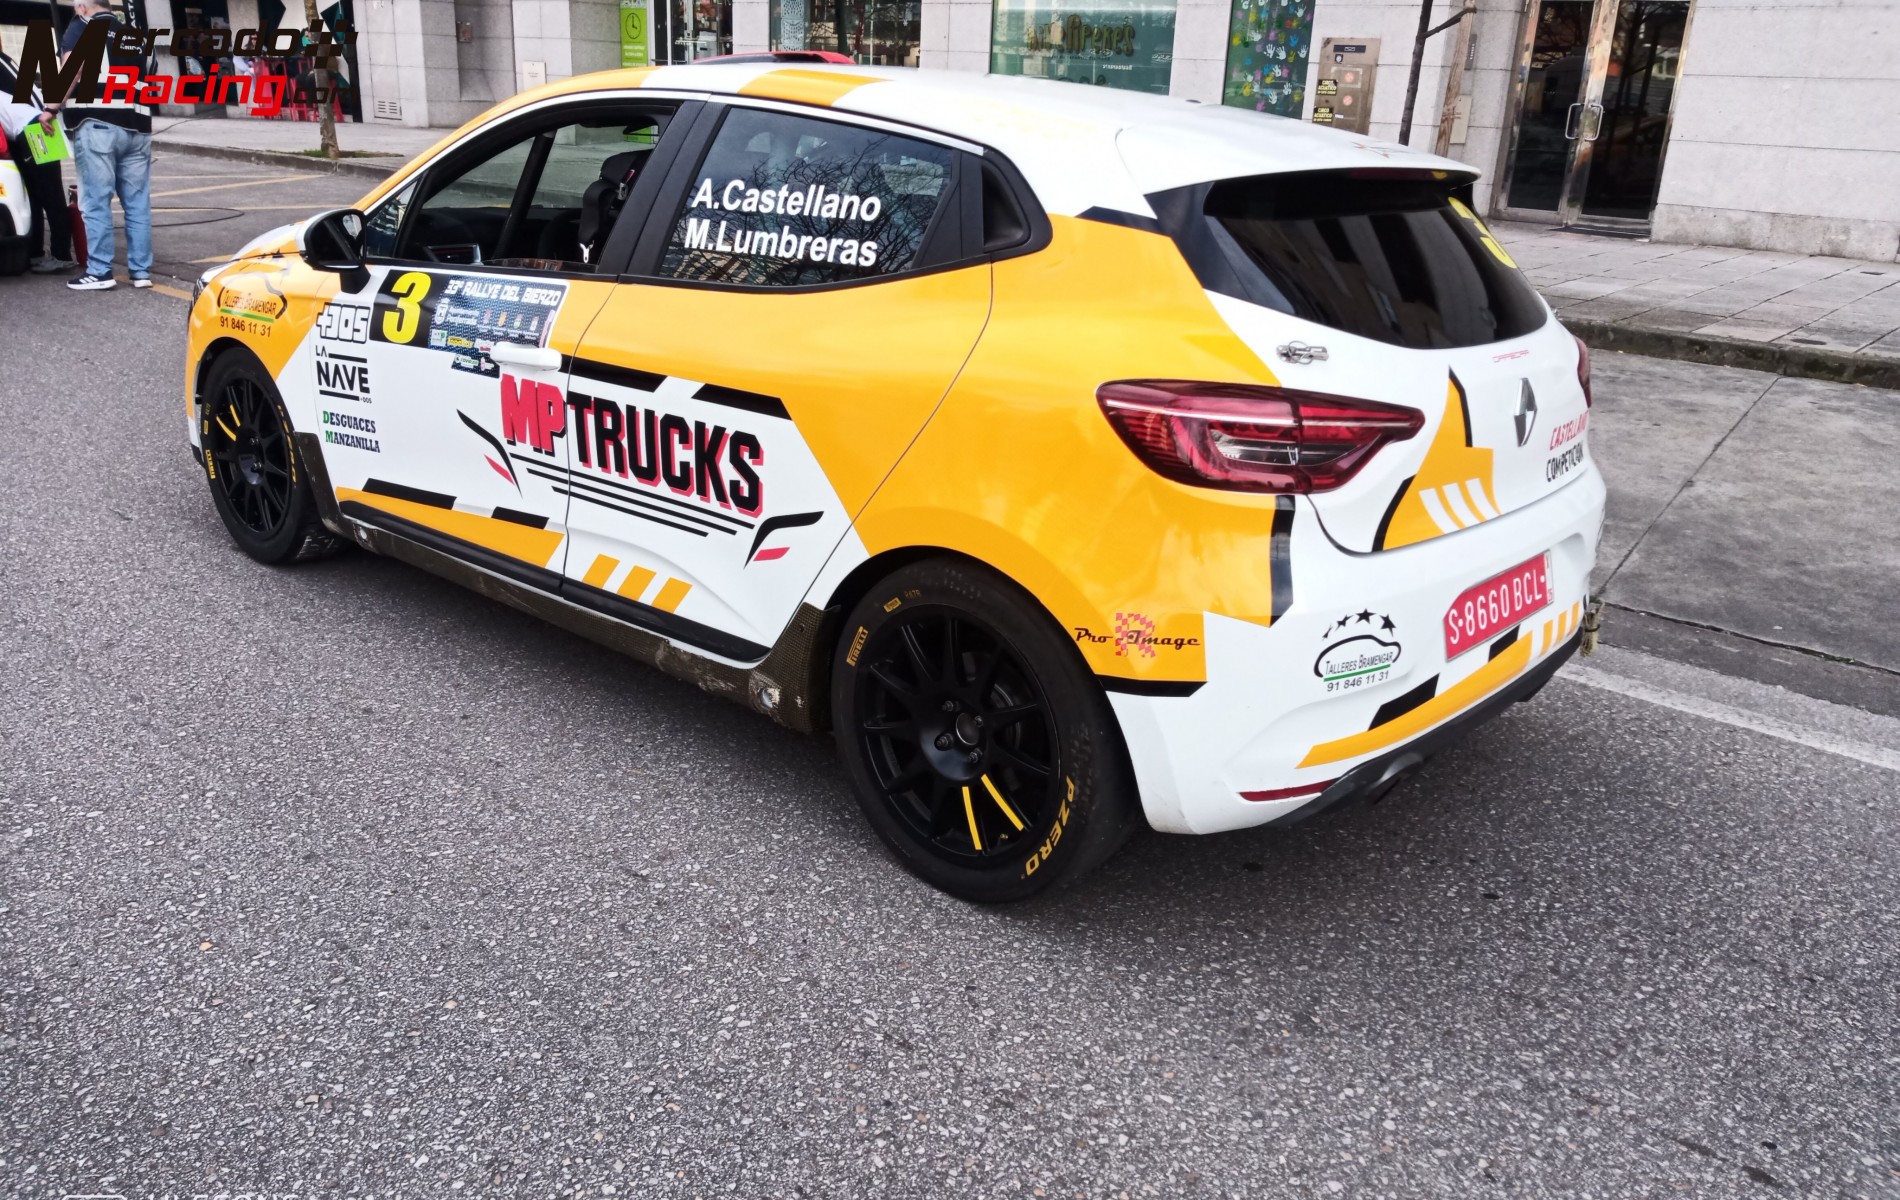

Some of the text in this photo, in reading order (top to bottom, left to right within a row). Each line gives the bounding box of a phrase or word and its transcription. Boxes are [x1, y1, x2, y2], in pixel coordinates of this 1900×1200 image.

[691, 177, 881, 222] A.Castellano
[683, 217, 878, 267] M.Lumbreras
[461, 281, 500, 299] RALLYE
[500, 285, 521, 301] DEL
[521, 287, 562, 307] BIERZO
[382, 272, 432, 344] 3
[220, 315, 271, 338] 91 846 11 31
[316, 360, 371, 394] NAVE
[322, 410, 376, 434] DESGUACES
[325, 430, 381, 453] MANZANILLA
[500, 373, 764, 519] MP TRUCKS
[846, 625, 869, 668] PIRELLI
[1074, 627, 1114, 642] Pro
[1325, 651, 1394, 675] TALLERES BRAMENGAR
[1327, 670, 1389, 692] 91 846 11 31
